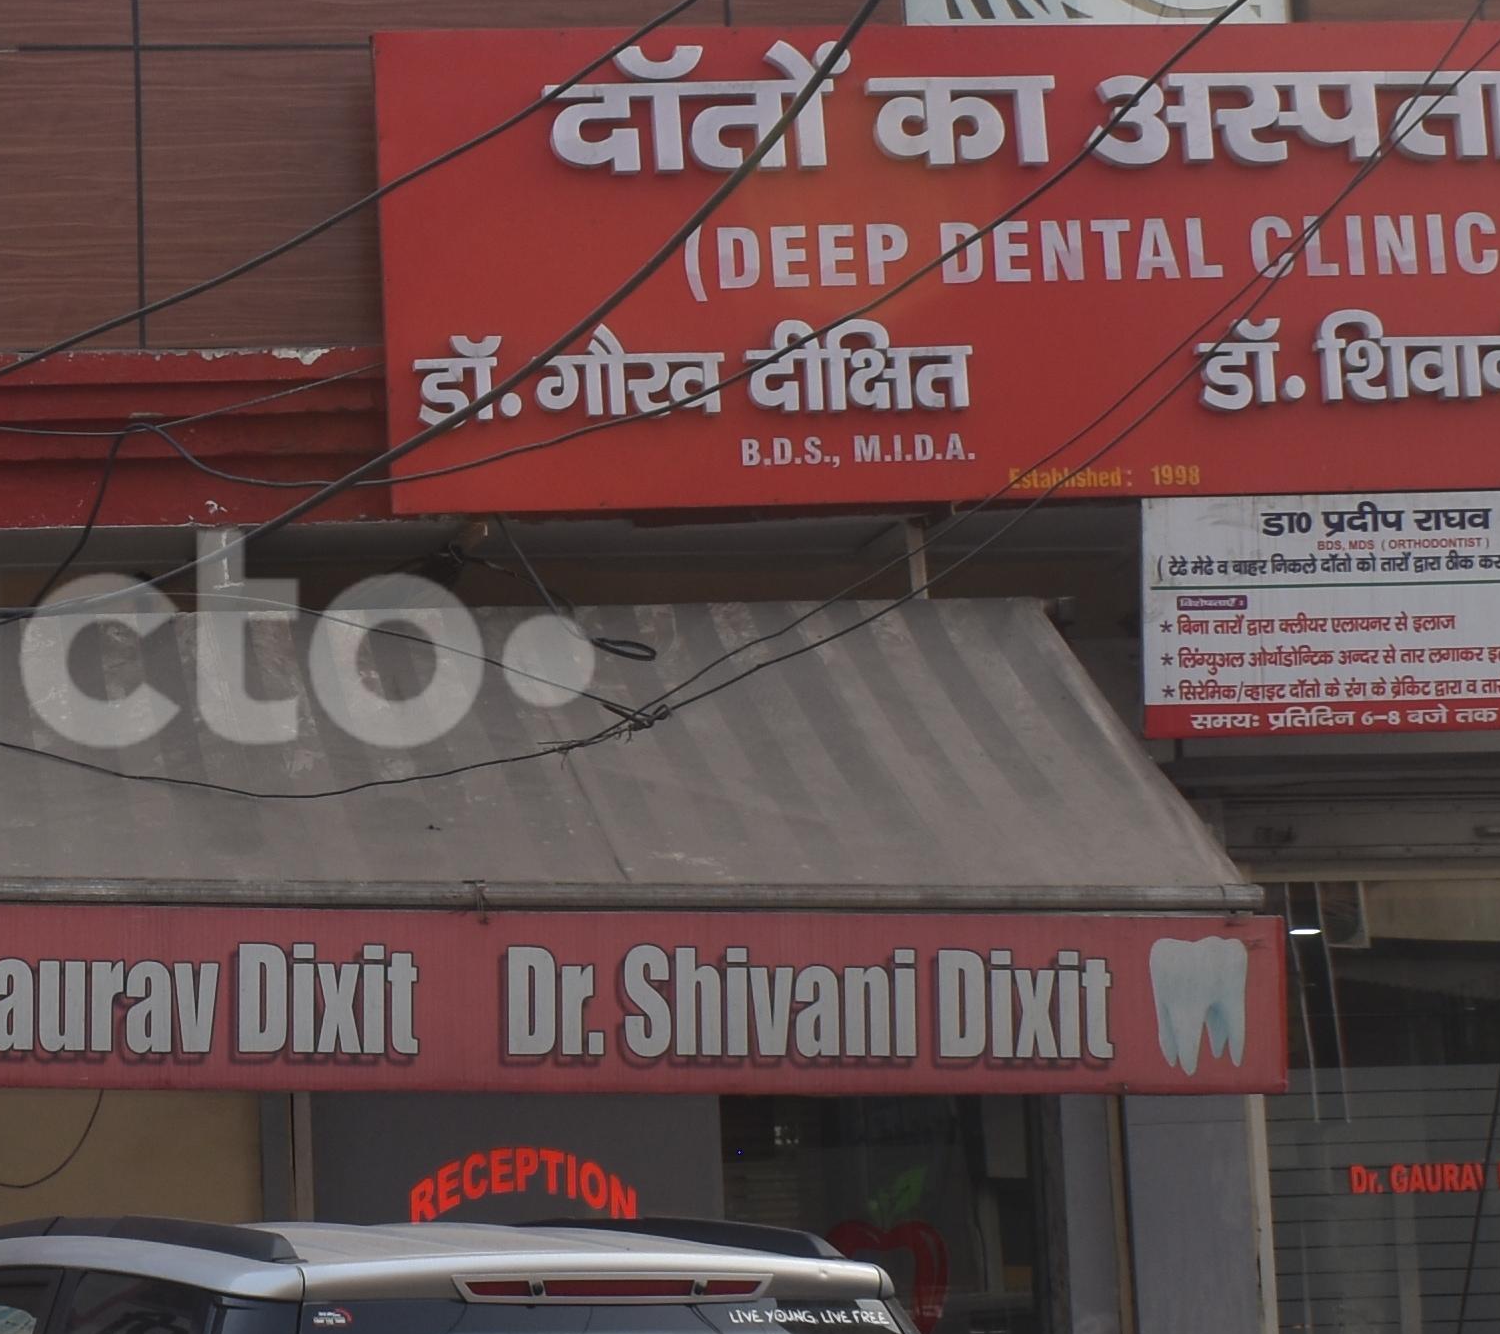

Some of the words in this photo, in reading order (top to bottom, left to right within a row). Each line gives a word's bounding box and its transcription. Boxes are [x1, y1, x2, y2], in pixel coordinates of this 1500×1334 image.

[864, 74, 1056, 167] का
[684, 222, 910, 302] (DEEP
[938, 215, 1224, 285] DENTAL
[413, 334, 523, 429] डॉ.
[532, 322, 727, 419] गौरव
[743, 318, 974, 414] दीक्षित
[1196, 317, 1306, 414] डॉ.
[741, 436, 841, 468] B.D.S.,
[853, 432, 976, 464] M.I.D.A.
[1150, 464, 1201, 486] 1998
[1316, 540, 1347, 553] BDS,
[1348, 540, 1374, 551] MDS
[1322, 500, 1404, 538] प्रदीप
[1413, 507, 1493, 532] राघव
[1177, 614, 1210, 636] बिना
[1213, 612, 1243, 634] तारों
[1246, 615, 1276, 636] द्वारा
[1278, 611, 1328, 634] क्लीयर
[1331, 616, 1392, 633] एलायनर
[1394, 611, 1409, 632] से
[1412, 613, 1457, 632] इलाज
[1267, 706, 1355, 731] प्रतिदिन
[1360, 710, 1401, 727] 6-8
[1406, 703, 1446, 725] बजे
[1455, 706, 1499, 723] तक
[237, 942, 420, 1056] Dixit
[506, 944, 606, 1057] Dr.
[622, 943, 919, 1060] Shivani
[936, 947, 1115, 1060] Dixit
[409, 1146, 638, 1224] RECEPTION
[729, 1309, 763, 1326] LIVE
[820, 1309, 852, 1327] LIVE
[852, 1310, 891, 1326] FREE
